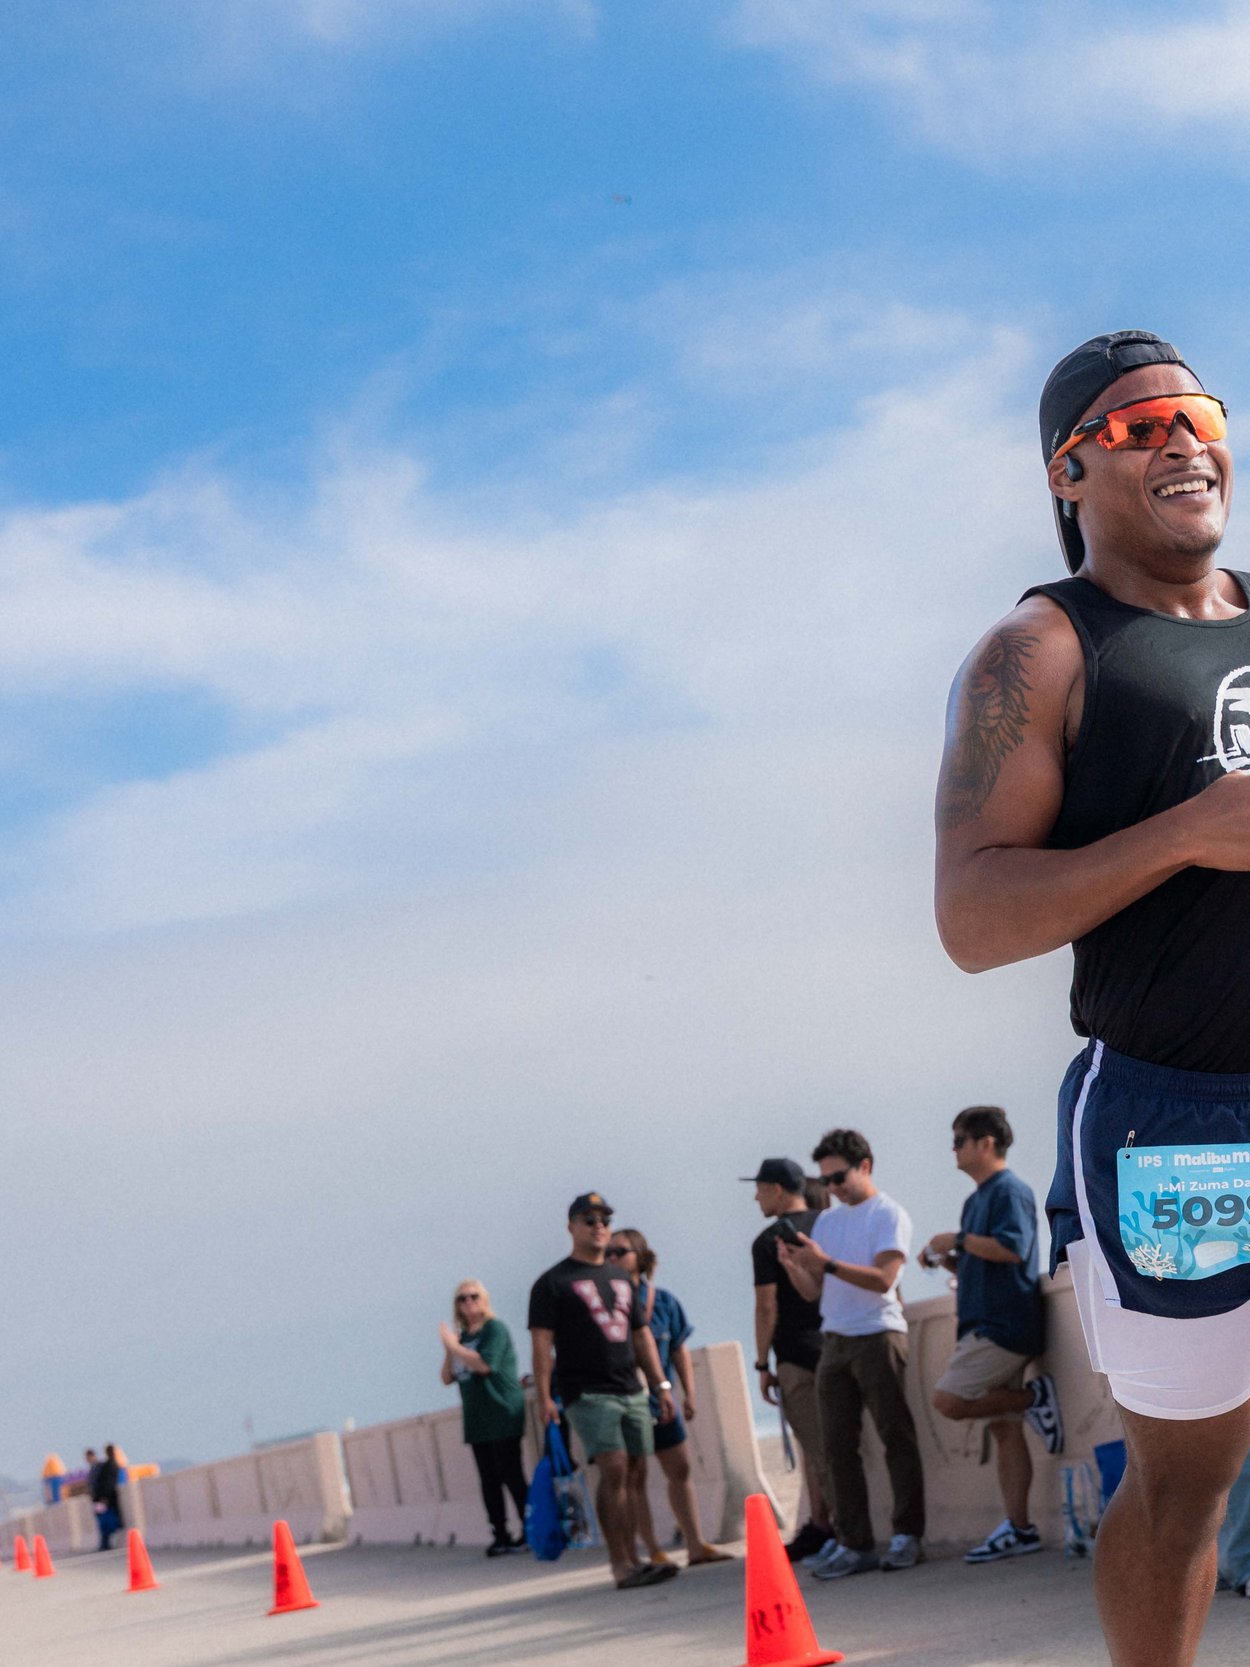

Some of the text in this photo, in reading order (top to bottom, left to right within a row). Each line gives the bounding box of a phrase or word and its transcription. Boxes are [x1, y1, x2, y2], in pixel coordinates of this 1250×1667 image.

[1138, 1155, 1163, 1168] IPS
[1158, 1181, 1185, 1193] 1-Mi
[1189, 1181, 1229, 1191] Zuma
